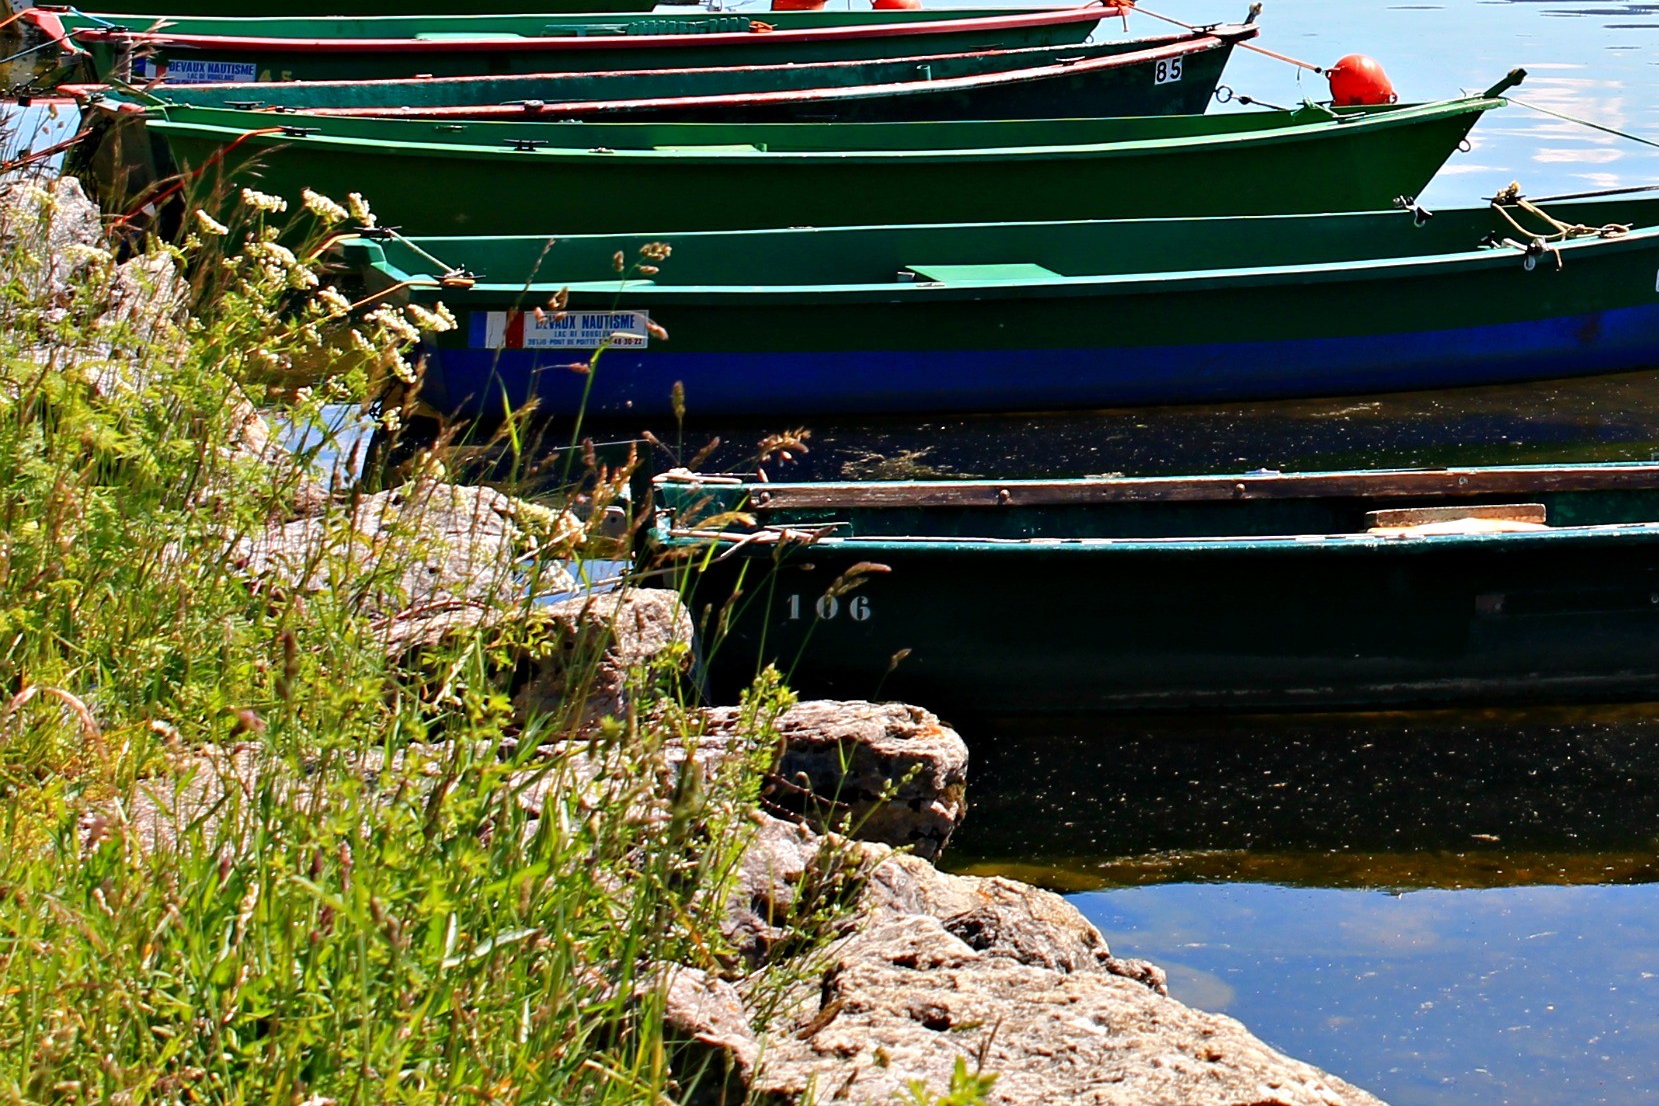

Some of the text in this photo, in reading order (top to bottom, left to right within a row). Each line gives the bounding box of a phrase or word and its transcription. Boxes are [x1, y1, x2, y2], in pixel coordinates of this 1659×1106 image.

[169, 62, 254, 75] DEVAUX NAUTISME
[1157, 58, 1181, 82] 85
[582, 314, 635, 330] NAUTISME
[581, 330, 614, 338] VOUGLAN
[786, 594, 871, 621] 106
